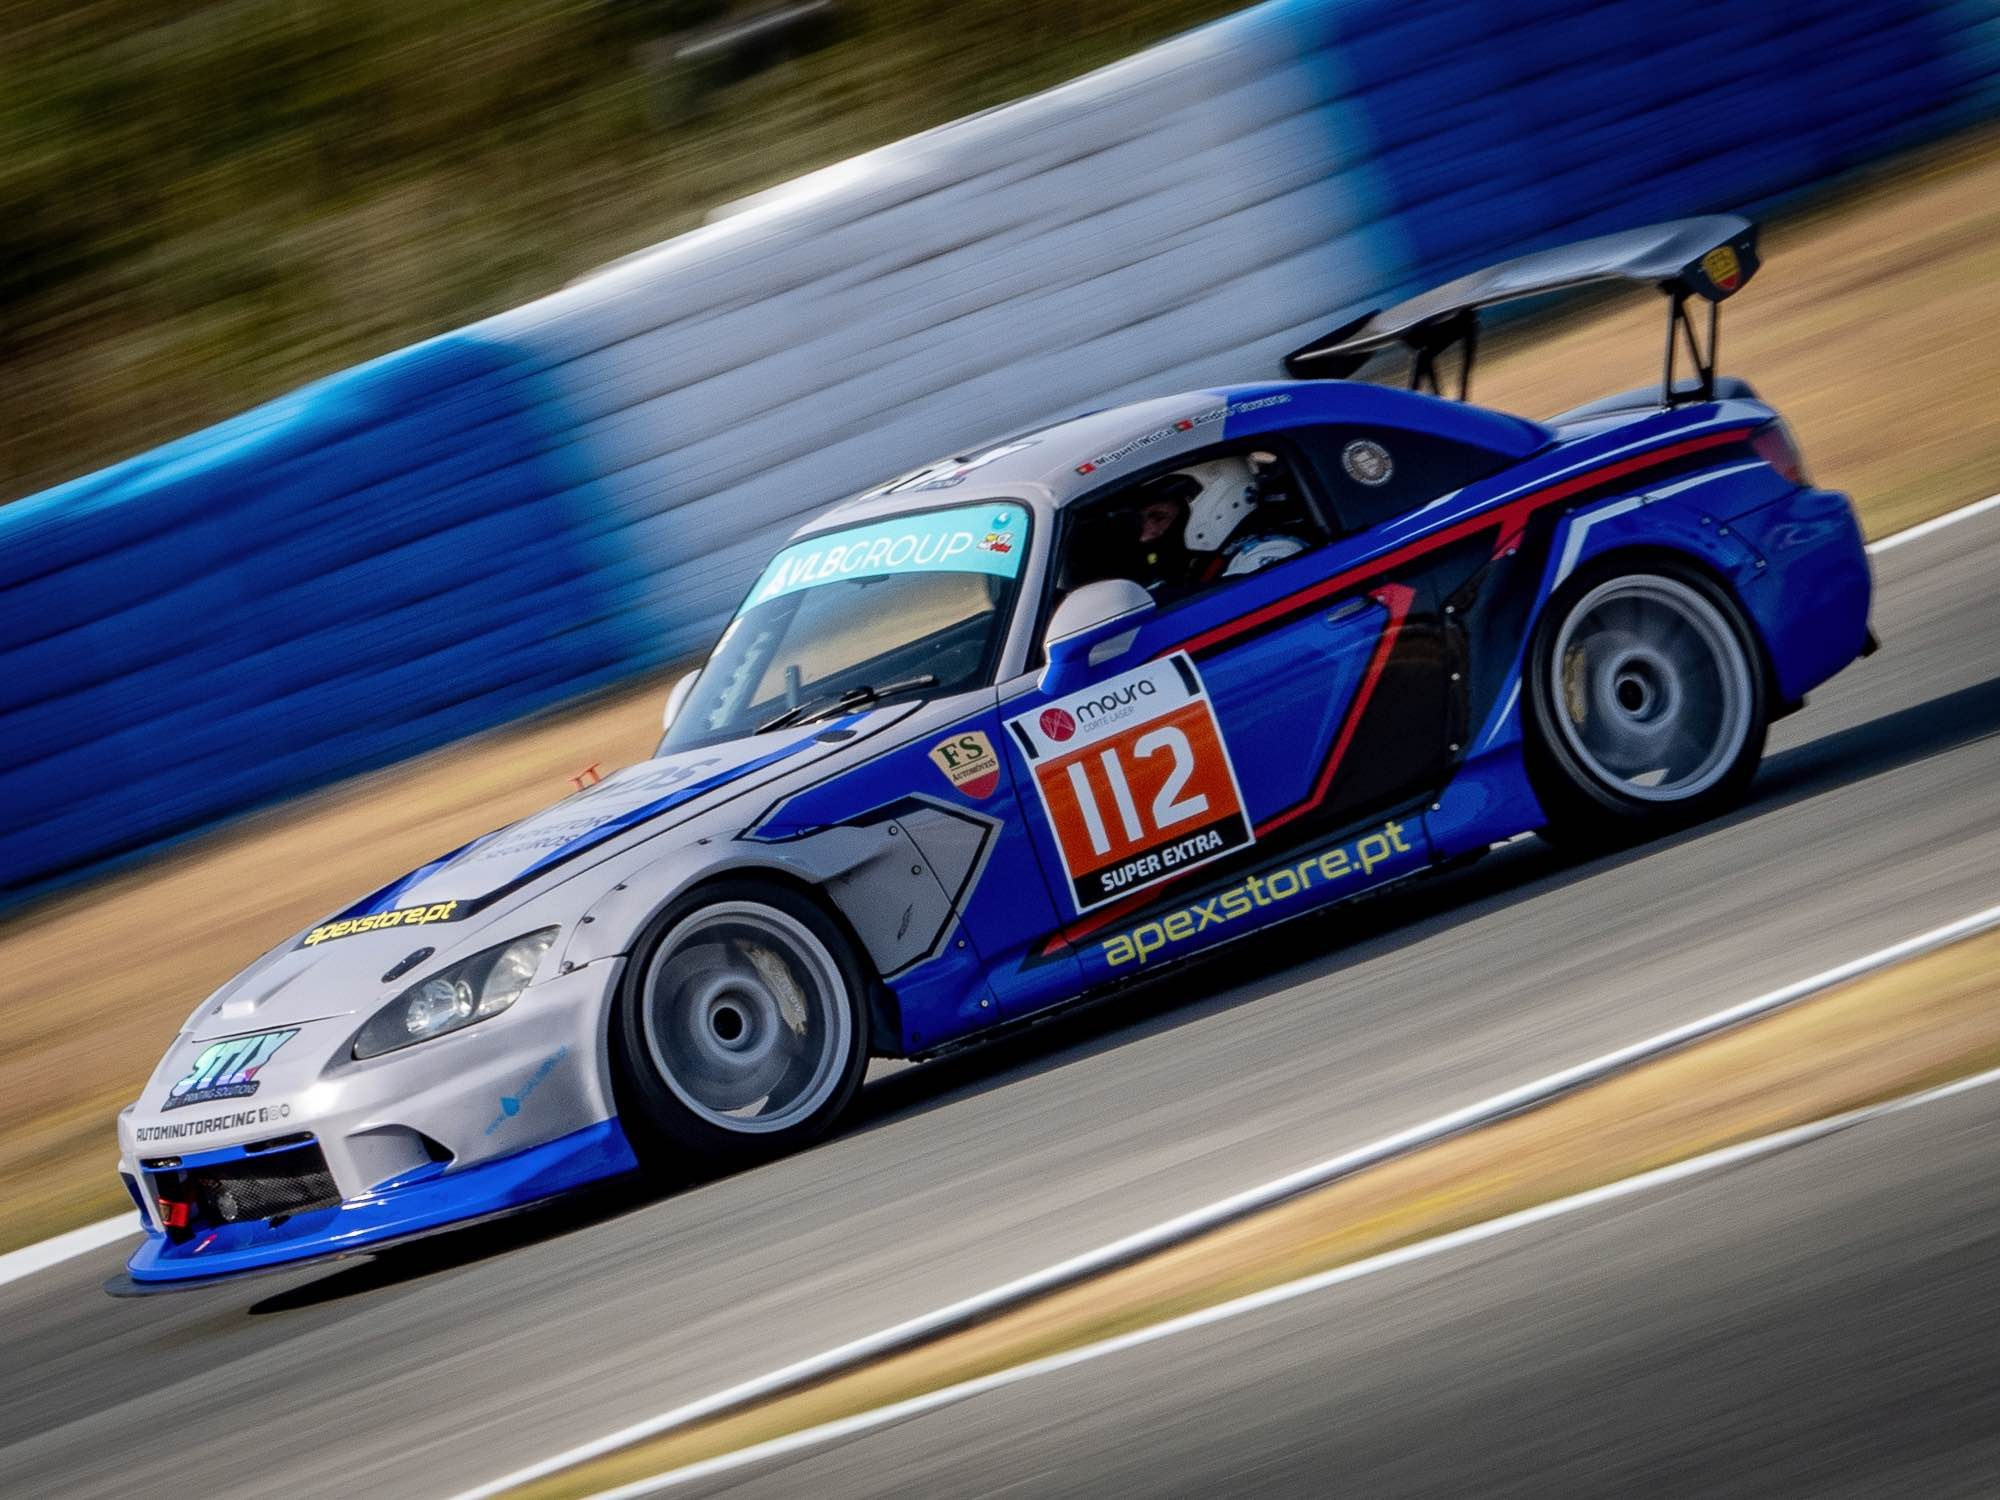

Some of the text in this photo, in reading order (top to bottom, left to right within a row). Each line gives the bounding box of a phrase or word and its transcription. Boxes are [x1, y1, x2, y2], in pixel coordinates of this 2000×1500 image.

[1076, 679, 1156, 723] moura
[937, 736, 983, 769] FS
[1067, 726, 1210, 855] 112
[1101, 830, 1223, 891] SUPER EXTRA
[1101, 821, 1411, 966] apexstore.pt
[304, 900, 457, 946] apexstore.pt
[136, 1111, 256, 1142] AUTOMINUTORACING
